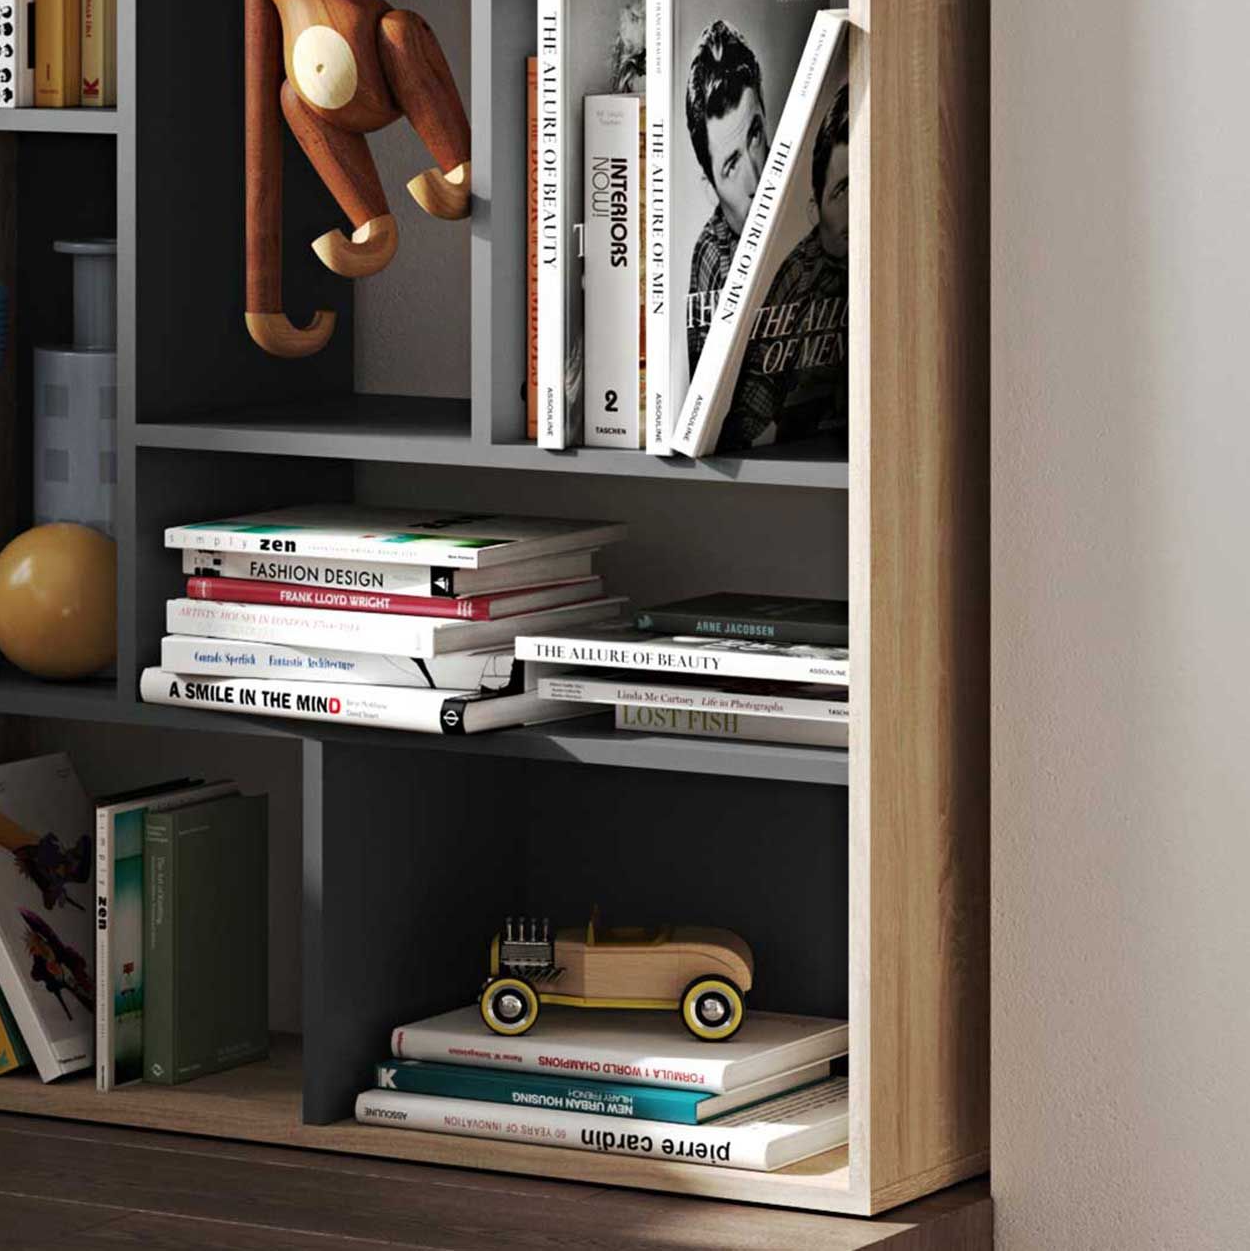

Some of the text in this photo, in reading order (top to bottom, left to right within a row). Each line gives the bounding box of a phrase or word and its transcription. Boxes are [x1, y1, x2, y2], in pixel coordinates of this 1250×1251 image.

[83, 78, 99, 95] K
[543, 11, 557, 268] THE ALLURE OF BEAUTY
[611, 158, 628, 268] INTERIORS
[652, 119, 664, 314] THE ALLURE OF MEN
[721, 139, 792, 324] THE ALLURE OF MEN
[687, 288, 723, 329] TH
[751, 296, 849, 340] THE ALLU
[762, 332, 845, 374] OF MEN
[605, 390, 618, 412] 2
[684, 395, 703, 441] ASSOULINE
[595, 426, 627, 436] TASCHEN
[260, 539, 297, 552] zen
[250, 561, 318, 582] FASHION
[325, 567, 384, 588] DESIGN
[280, 590, 390, 610] FRANK LLOYD WRIGHT
[696, 621, 774, 637] ARNE JACOBSEN
[269, 654, 355, 671] Fantastic Architecture
[534, 643, 721, 671] THE ALLURE OF BEAUTY
[809, 667, 846, 677] ASSOULINE
[169, 681, 341, 715] A SMILE IN THE MIND
[617, 690, 642, 701] Linda
[661, 692, 694, 706] Cartney
[702, 697, 718, 707] Life
[730, 699, 784, 713] Photographs
[622, 705, 740, 734] LOST FISH
[828, 708, 849, 717] TASCH
[98, 896, 107, 930] zen
[378, 1068, 397, 1088] K
[538, 1056, 705, 1084] FORMULA 1 WORLD CHAMPIONS
[512, 1092, 633, 1115] NEW URBAN HOUSING
[568, 1089, 633, 1103] HILARY FRENCH
[365, 1107, 407, 1121] ASSOULINE
[444, 1115, 566, 1139] 60 YEARS OF INNOVATION
[581, 1128, 731, 1163] pierre cardin
